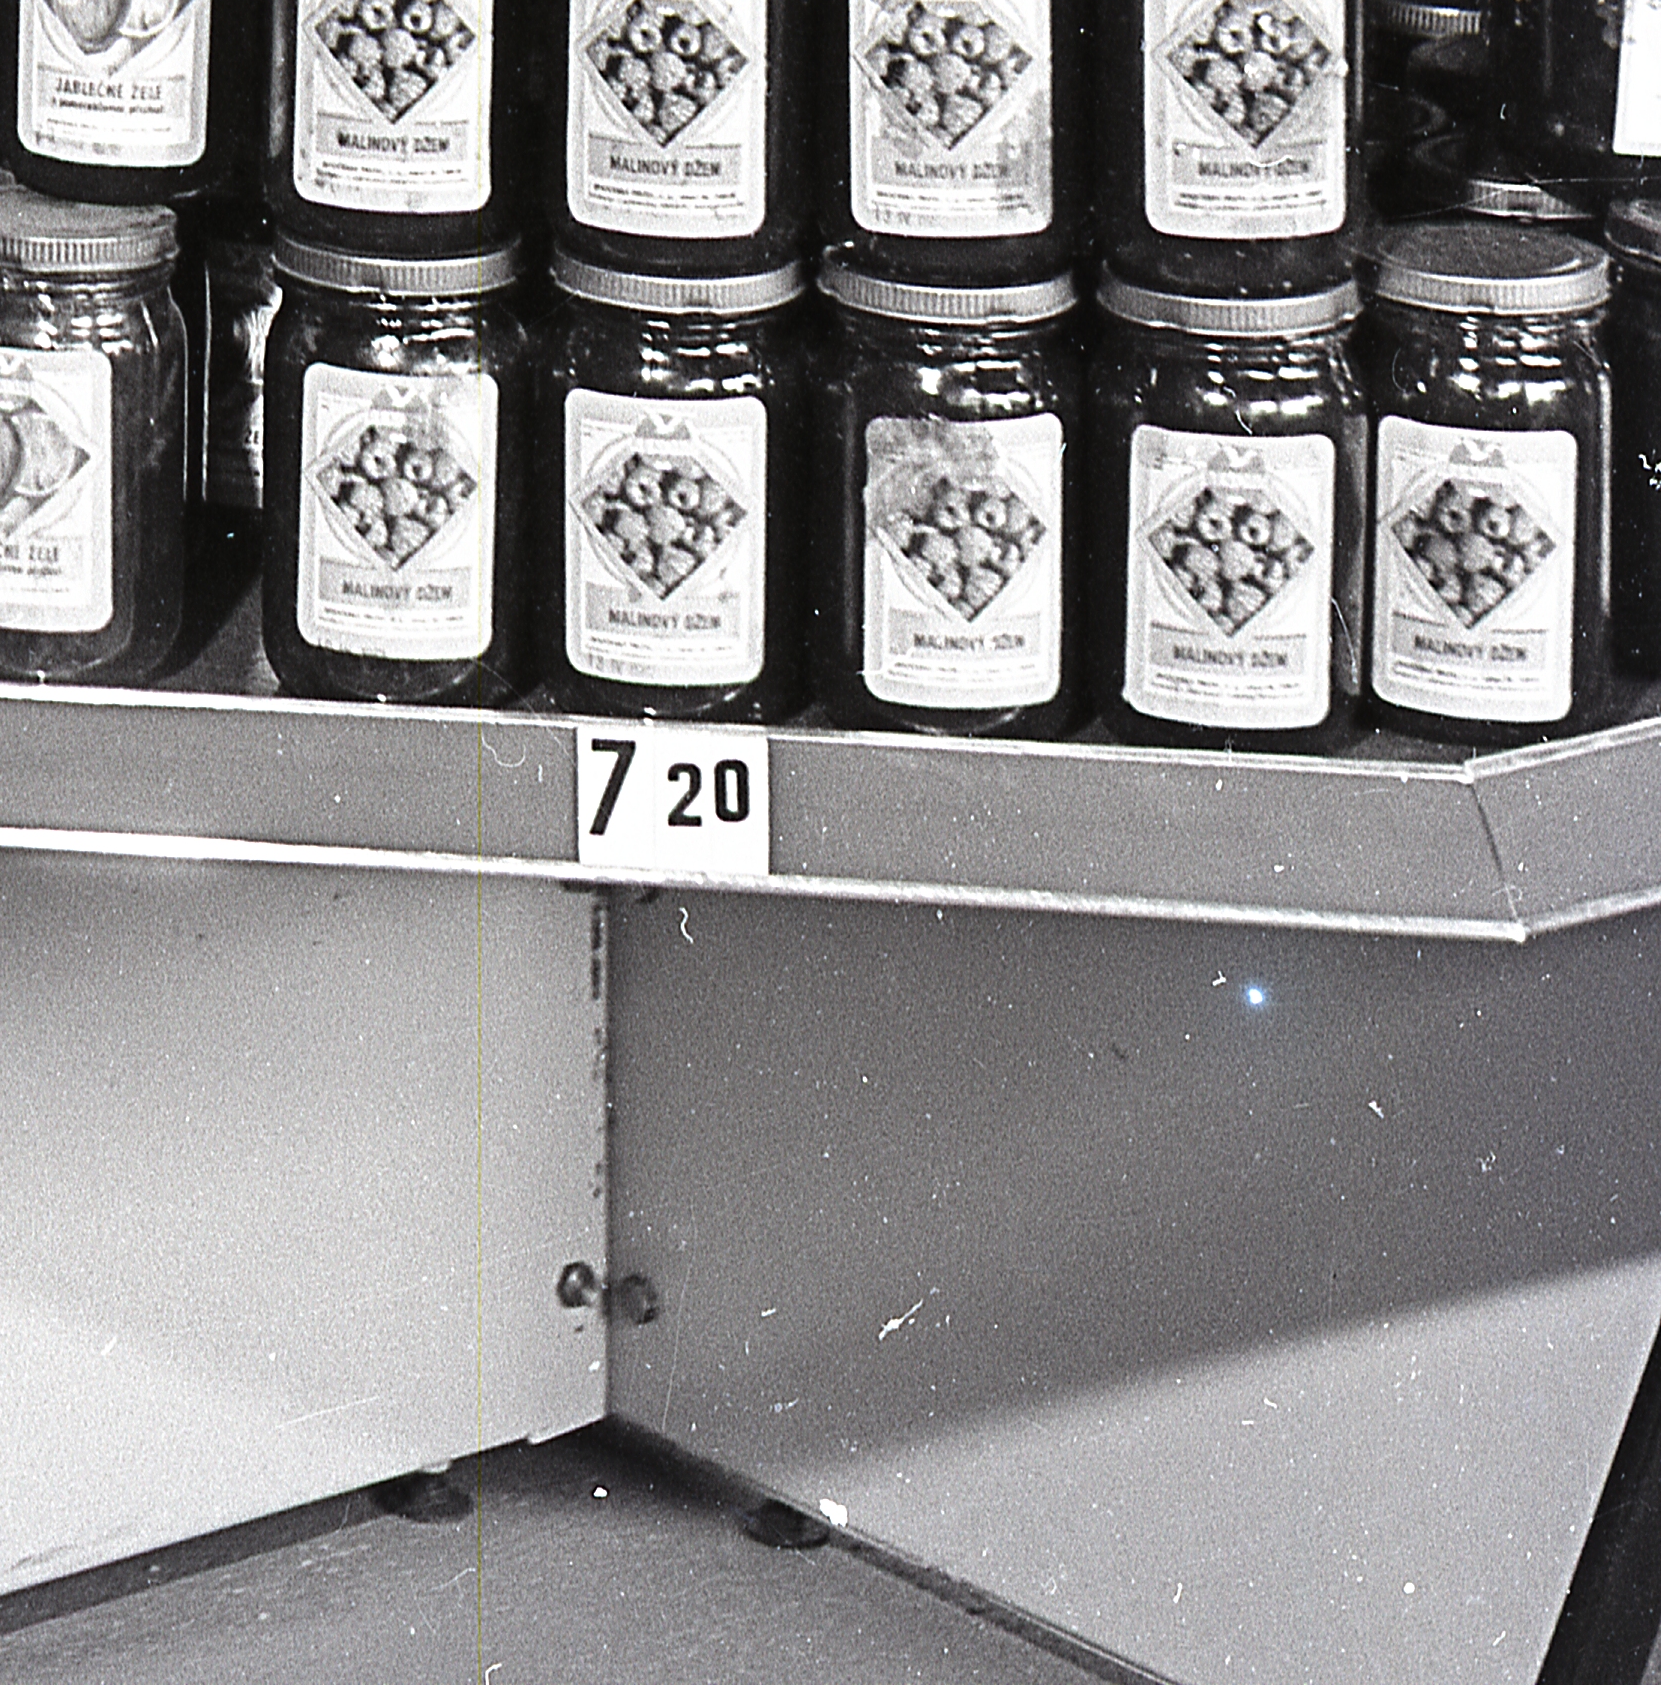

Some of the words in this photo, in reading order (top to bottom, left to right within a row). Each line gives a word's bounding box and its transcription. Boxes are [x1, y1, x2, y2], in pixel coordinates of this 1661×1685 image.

[54, 76, 124, 101] JABLEČNÉ
[130, 79, 164, 102] ŽELÉ
[588, 738, 638, 837] 7
[665, 758, 751, 829] 20
